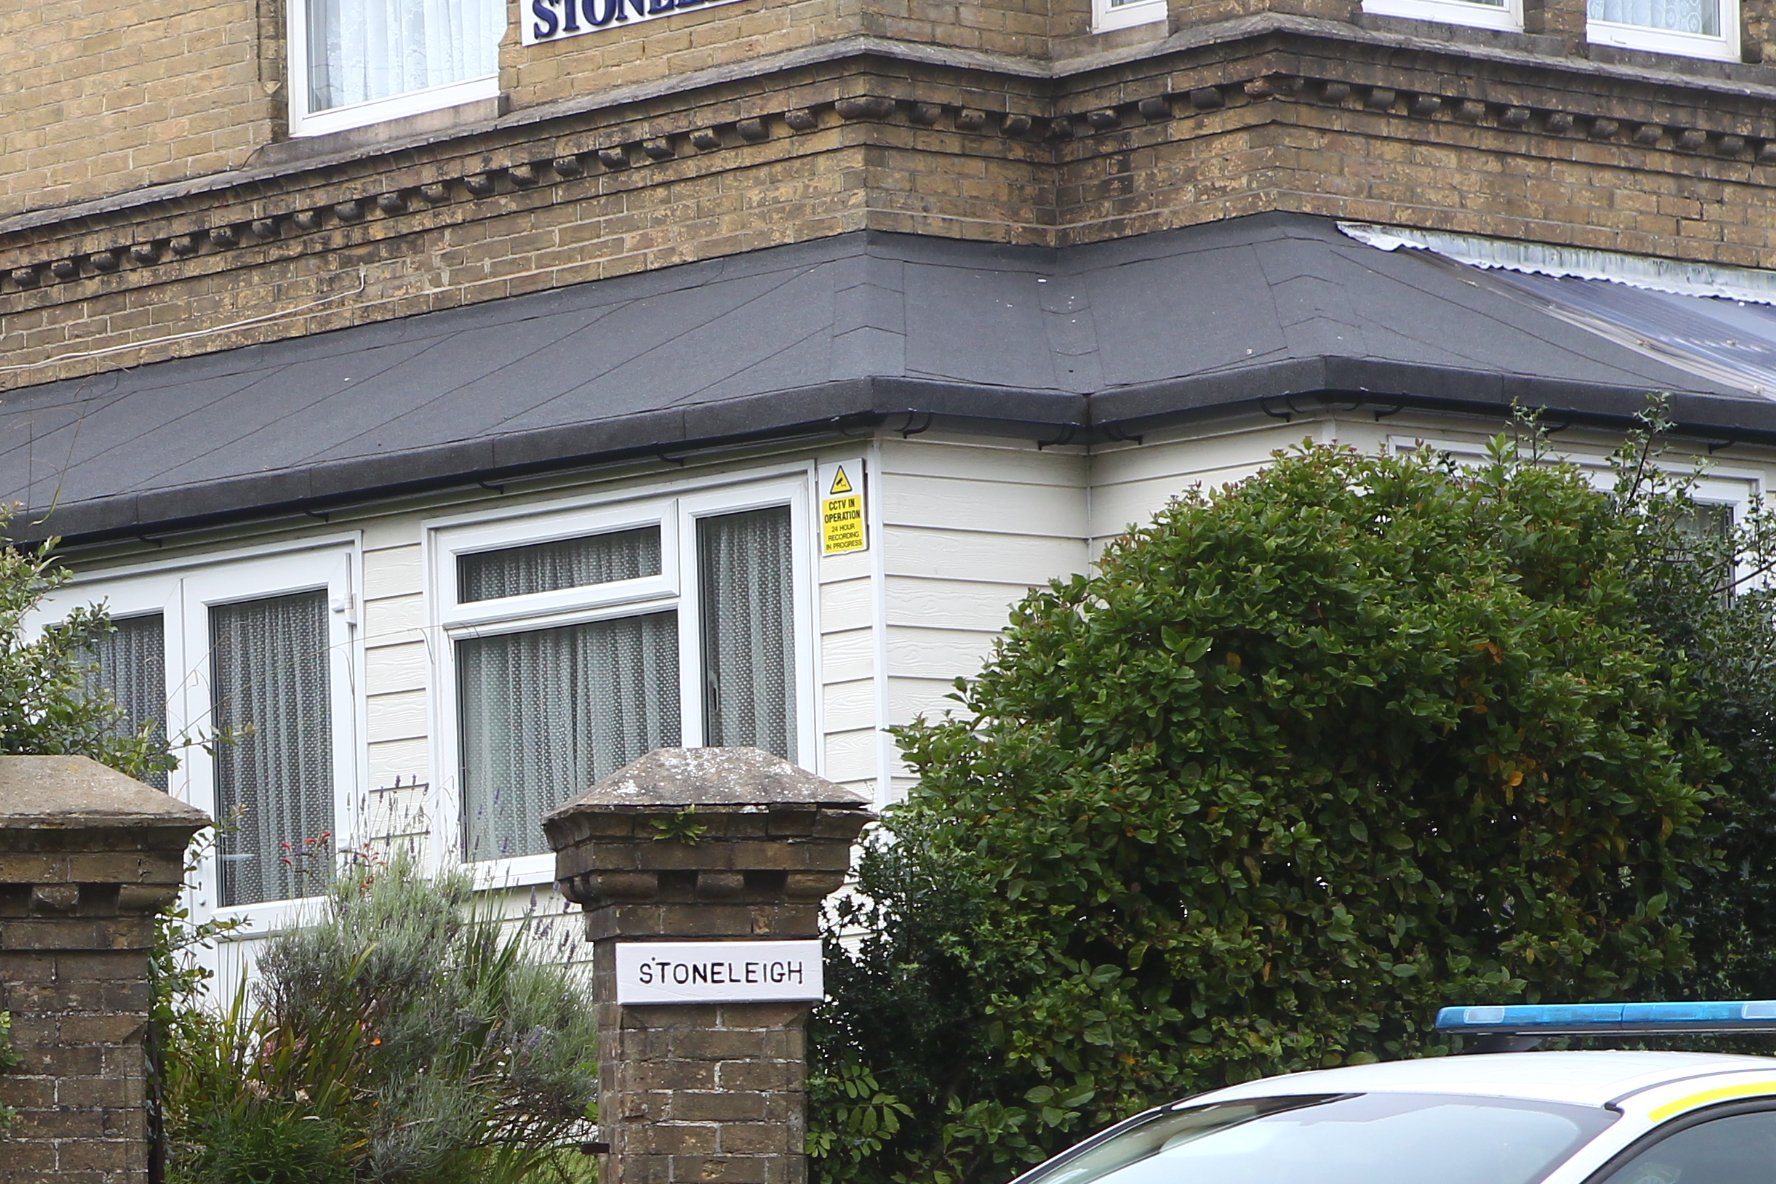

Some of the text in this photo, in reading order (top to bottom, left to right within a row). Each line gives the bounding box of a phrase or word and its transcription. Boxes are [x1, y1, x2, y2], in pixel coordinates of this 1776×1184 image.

[828, 498, 856, 511] CCTV IN
[824, 509, 861, 524] OPERATION
[839, 523, 856, 531] HOUR
[827, 531, 860, 542] RECORDING
[826, 539, 863, 551] IN PROGRESS
[638, 960, 804, 985] STONELEIGH
